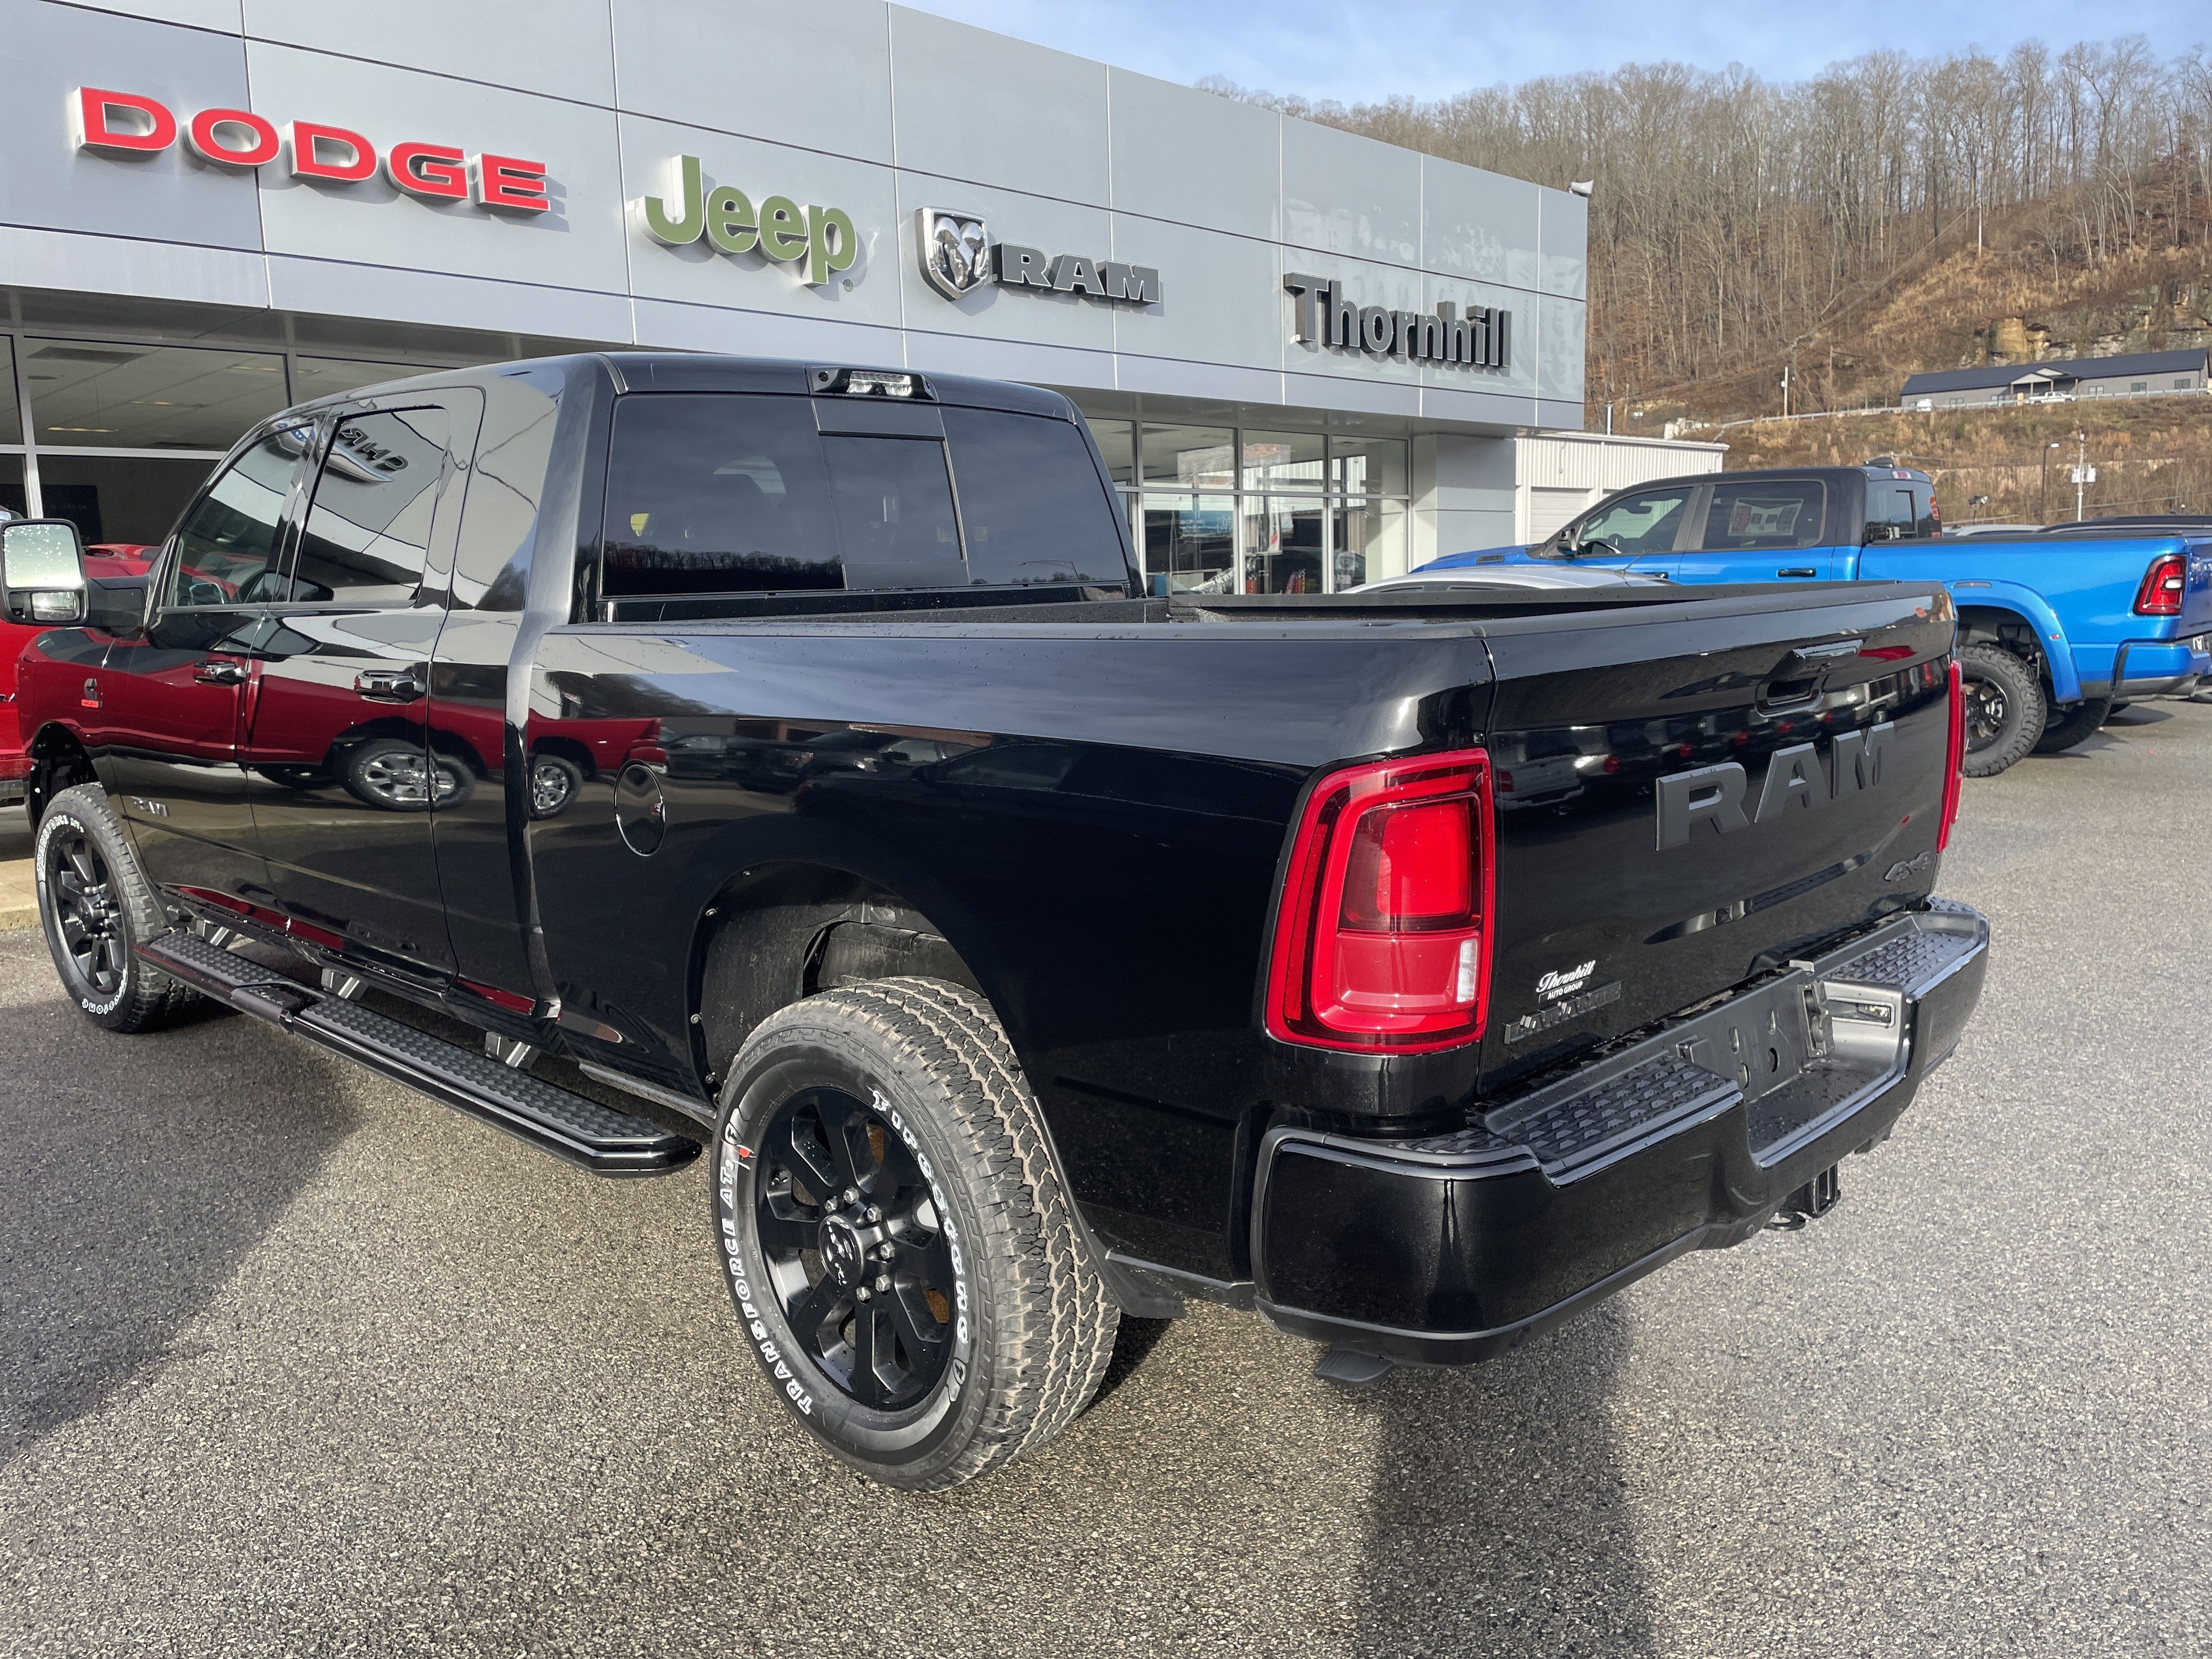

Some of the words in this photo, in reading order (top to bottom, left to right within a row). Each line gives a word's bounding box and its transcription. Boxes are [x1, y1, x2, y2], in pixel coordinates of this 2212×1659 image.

[77, 86, 551, 213] DODGE
[640, 154, 857, 286] Jeep
[992, 242, 1161, 304] RAM
[1284, 272, 1513, 367] Thornhill
[1656, 720, 1895, 851] RAM
[1536, 960, 1596, 993] Thornhill
[1547, 989, 1563, 1000] AUTO
[1564, 981, 1583, 994] GROUP
[721, 1217, 813, 1415] TRANSFORCE
